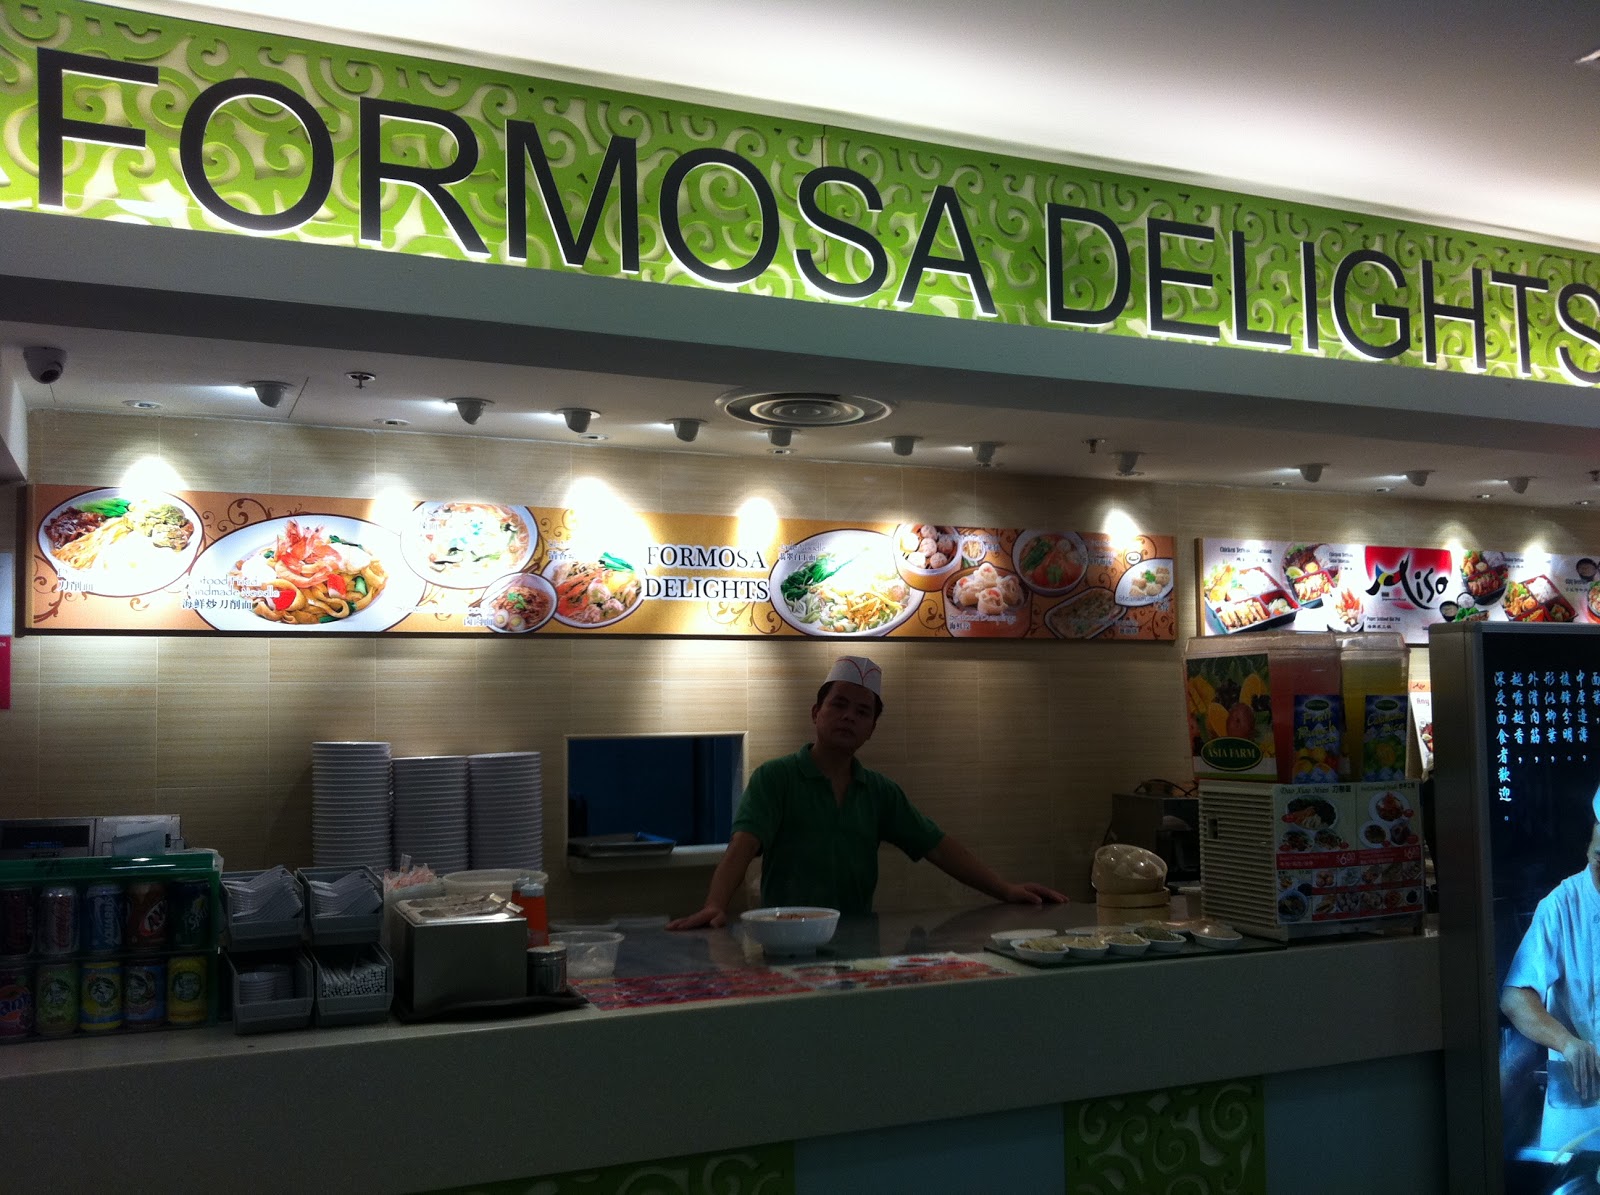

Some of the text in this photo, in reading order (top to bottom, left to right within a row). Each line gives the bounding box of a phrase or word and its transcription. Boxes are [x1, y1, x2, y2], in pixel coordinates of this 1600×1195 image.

[37, 47, 1600, 387] FORMOSA DELIGHTS
[647, 545, 767, 569] FORMOSA
[645, 576, 770, 601] DELIGHTS
[1365, 553, 1449, 610] Miso
[1208, 748, 1256, 758] ASIA FARM
